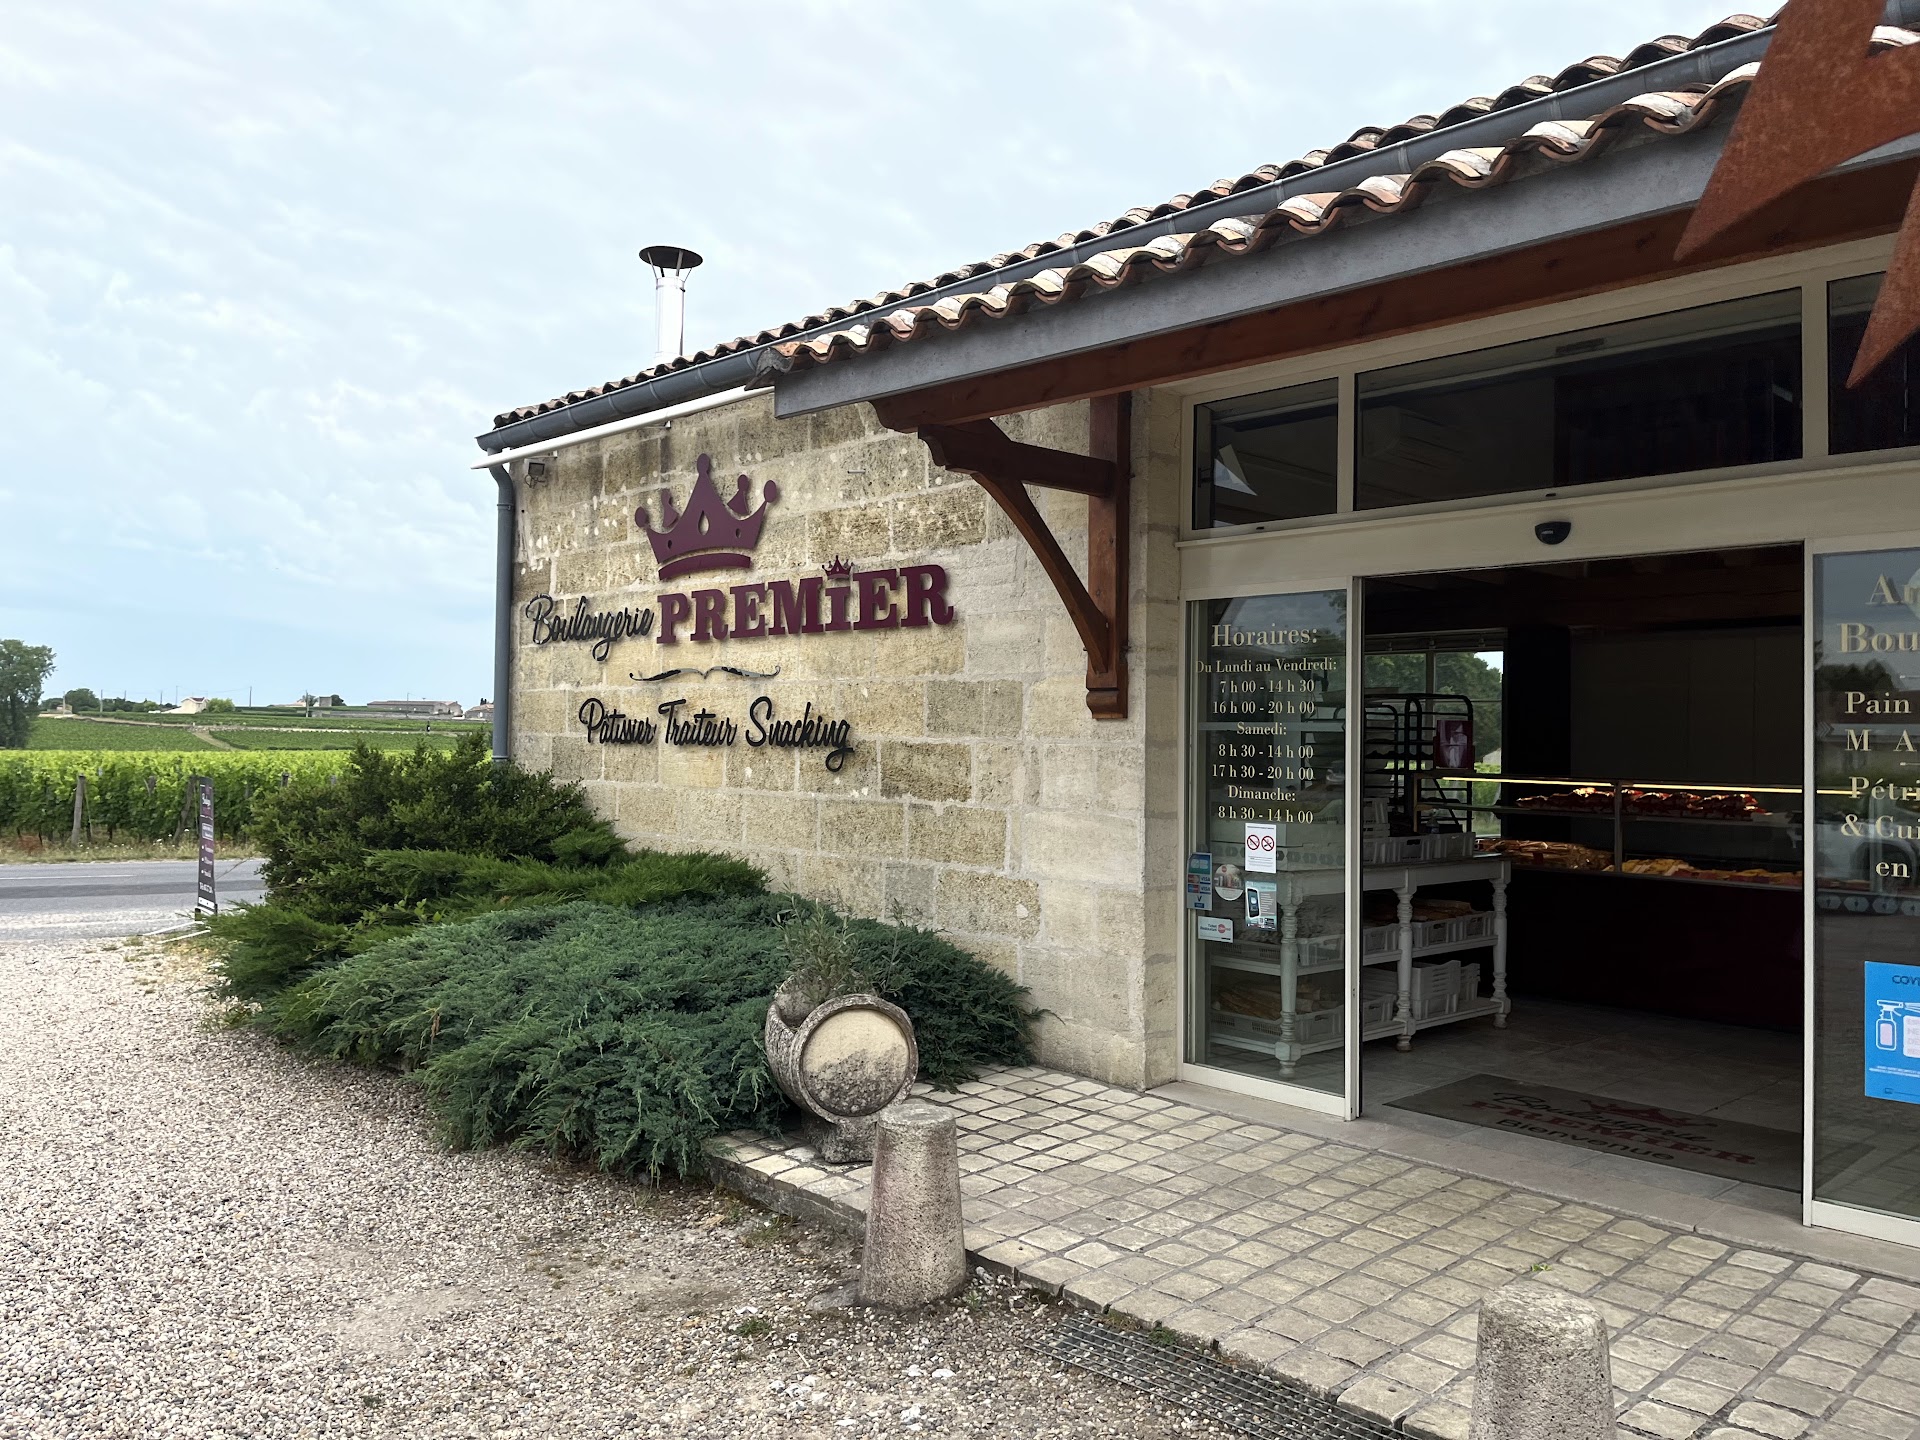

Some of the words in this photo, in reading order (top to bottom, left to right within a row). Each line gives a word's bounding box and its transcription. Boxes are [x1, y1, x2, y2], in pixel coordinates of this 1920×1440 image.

[526, 594, 655, 662] Boulangerie
[1211, 623, 1317, 647] Horaires:
[1196, 661, 1212, 673] Du
[1216, 660, 1252, 673] Lundi
[1256, 663, 1271, 672] au
[1275, 657, 1337, 671] Vendredi:
[1219, 681, 1227, 693] 7
[1230, 680, 1238, 693] h
[1241, 680, 1256, 692] 00
[1268, 680, 1283, 692] 14
[1287, 680, 1295, 692] h
[1299, 679, 1315, 692] 30
[1213, 702, 1226, 714] 16
[1230, 701, 1238, 714] h
[1241, 701, 1256, 714] 00
[1268, 701, 1283, 714] 20
[1287, 701, 1295, 714] h
[1299, 701, 1315, 714] 00
[1844, 691, 1912, 714] Pain
[658, 698, 737, 747] Traiteur
[745, 696, 854, 772] Snacking
[1236, 721, 1287, 735] Samedi:
[1218, 744, 1226, 756] 8
[1229, 744, 1237, 756] h
[1240, 745, 1255, 757] 30
[1267, 745, 1282, 757] 14
[1286, 745, 1294, 758] h
[1298, 745, 1314, 759] 00
[1212, 764, 1226, 777] 17
[1229, 765, 1237, 777] h
[1240, 766, 1255, 778] 30
[1267, 766, 1282, 779] 20
[1286, 767, 1294, 779] h
[1298, 767, 1314, 780] 00
[1228, 785, 1296, 801] Dimanche:
[1218, 806, 1226, 818] 8
[1229, 806, 1237, 819] h
[1240, 807, 1255, 820] 30
[1267, 808, 1282, 821] 14
[1286, 809, 1294, 822] h
[1297, 810, 1314, 824] 00
[1840, 814, 1864, 836] &
[1875, 861, 1910, 878] en
[1496, 1118, 1675, 1160] Bienvenue
